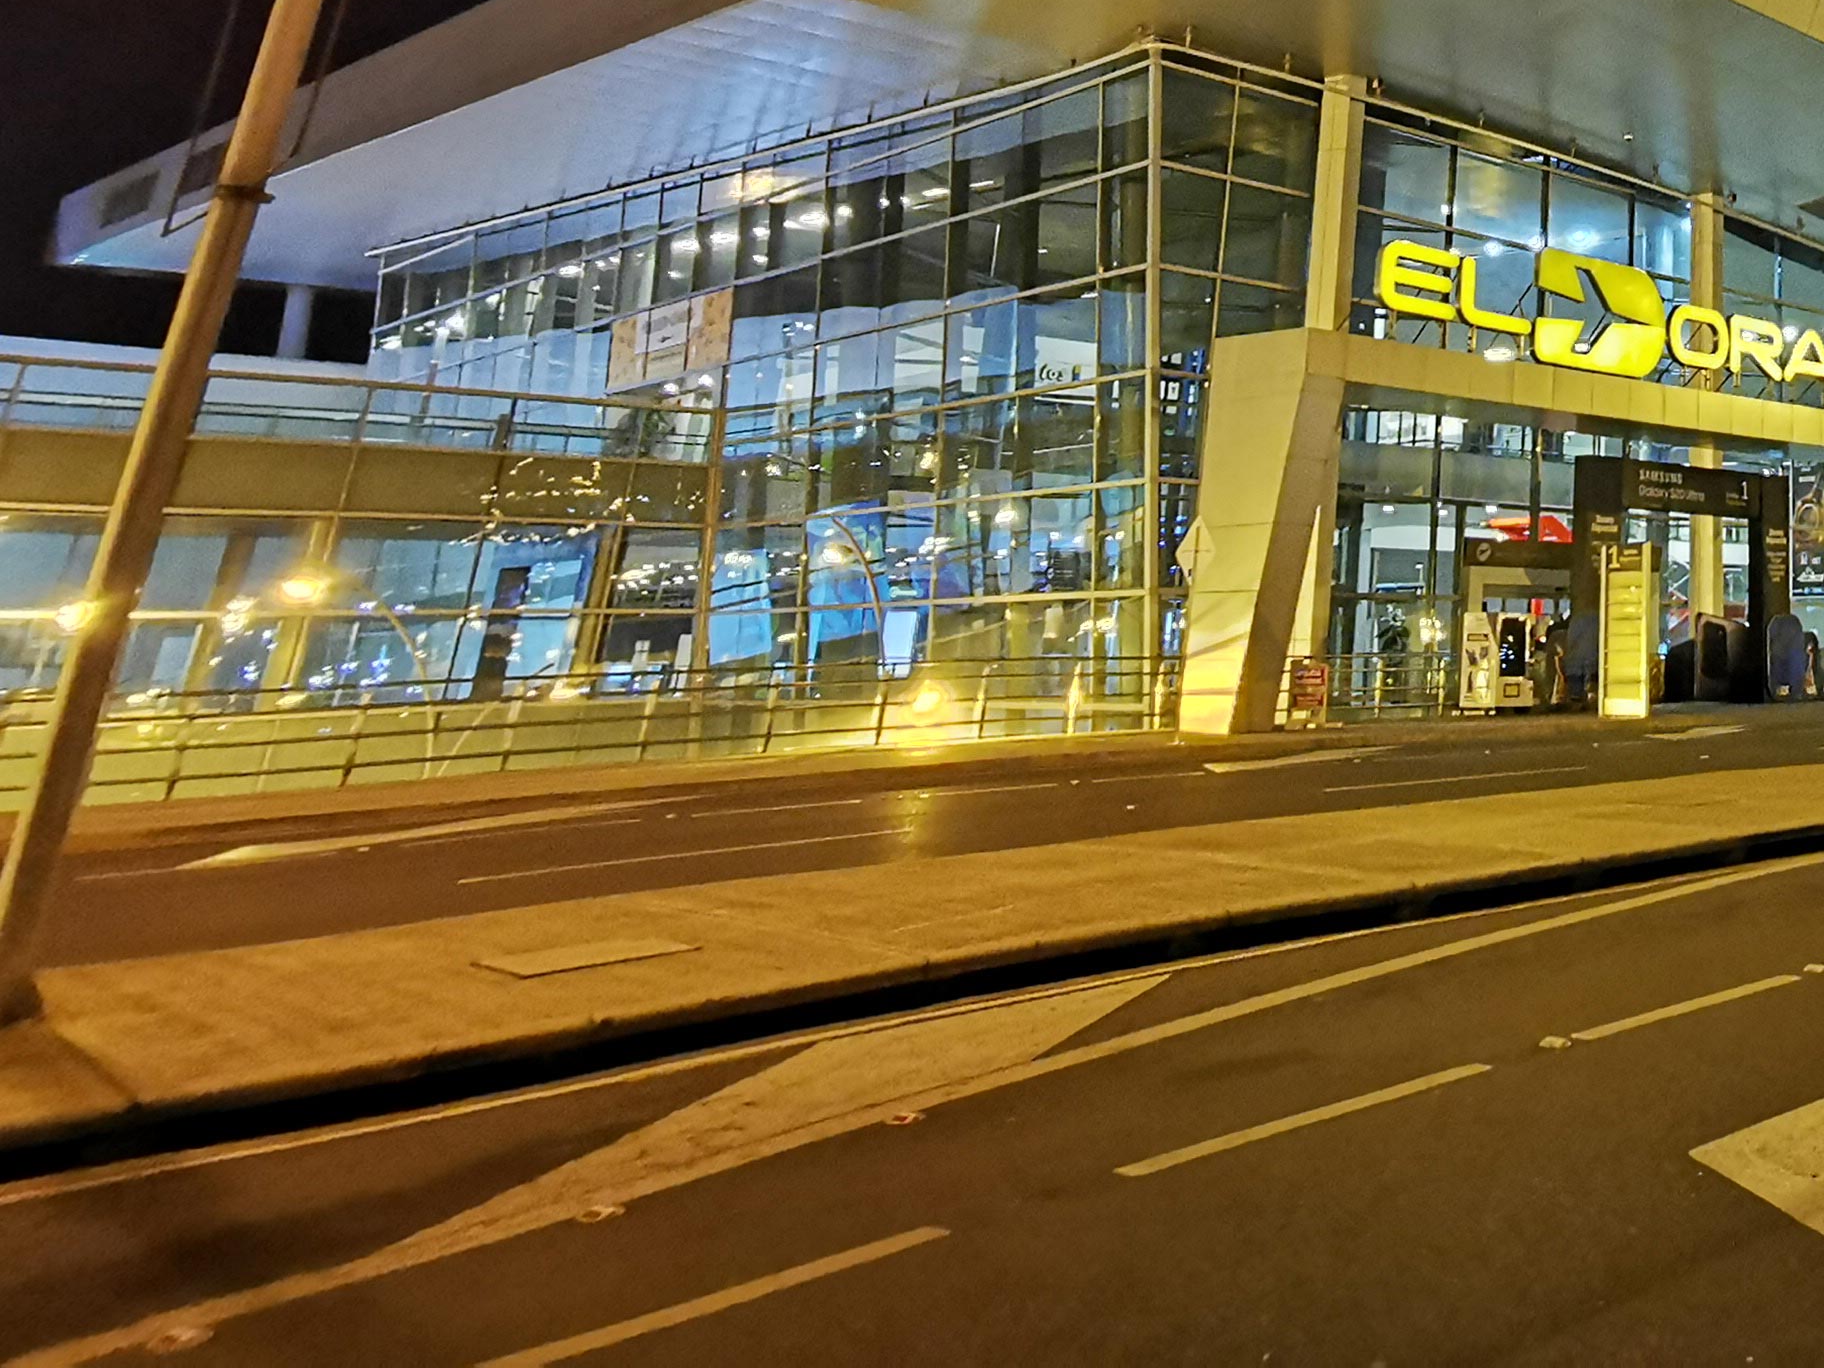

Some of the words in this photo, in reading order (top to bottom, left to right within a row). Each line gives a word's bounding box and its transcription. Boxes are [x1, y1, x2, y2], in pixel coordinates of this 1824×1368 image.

[1374, 238, 1533, 336] EL
[1740, 480, 1750, 501] 1
[1607, 544, 1621, 570] 1
